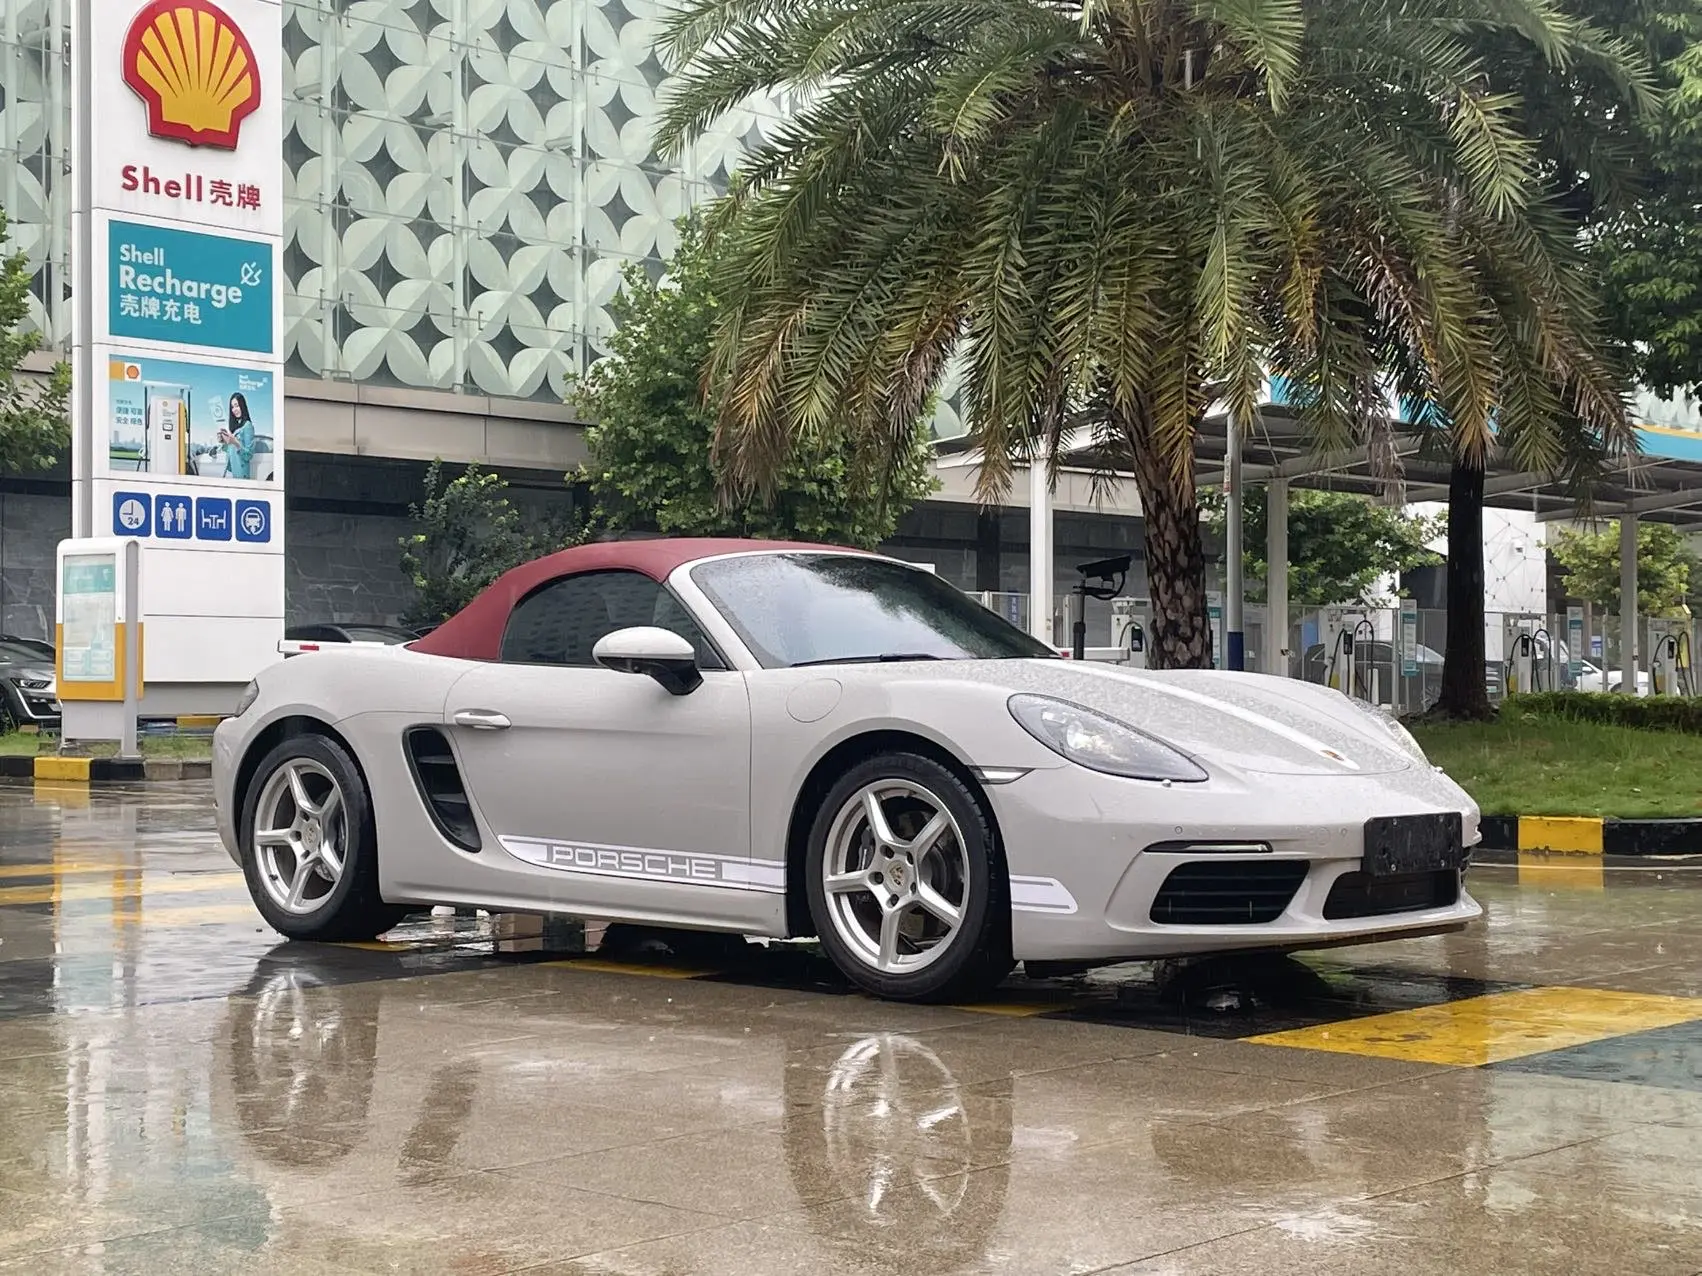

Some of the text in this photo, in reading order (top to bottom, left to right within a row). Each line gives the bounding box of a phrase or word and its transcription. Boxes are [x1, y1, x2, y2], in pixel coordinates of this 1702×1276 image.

[121, 164, 262, 211] Shell 壳牌
[119, 243, 165, 266] Shell
[119, 264, 243, 309] Recharge
[120, 293, 202, 325] 壳牌充电
[127, 516, 139, 526] 24
[551, 845, 716, 879] PORSCHE
